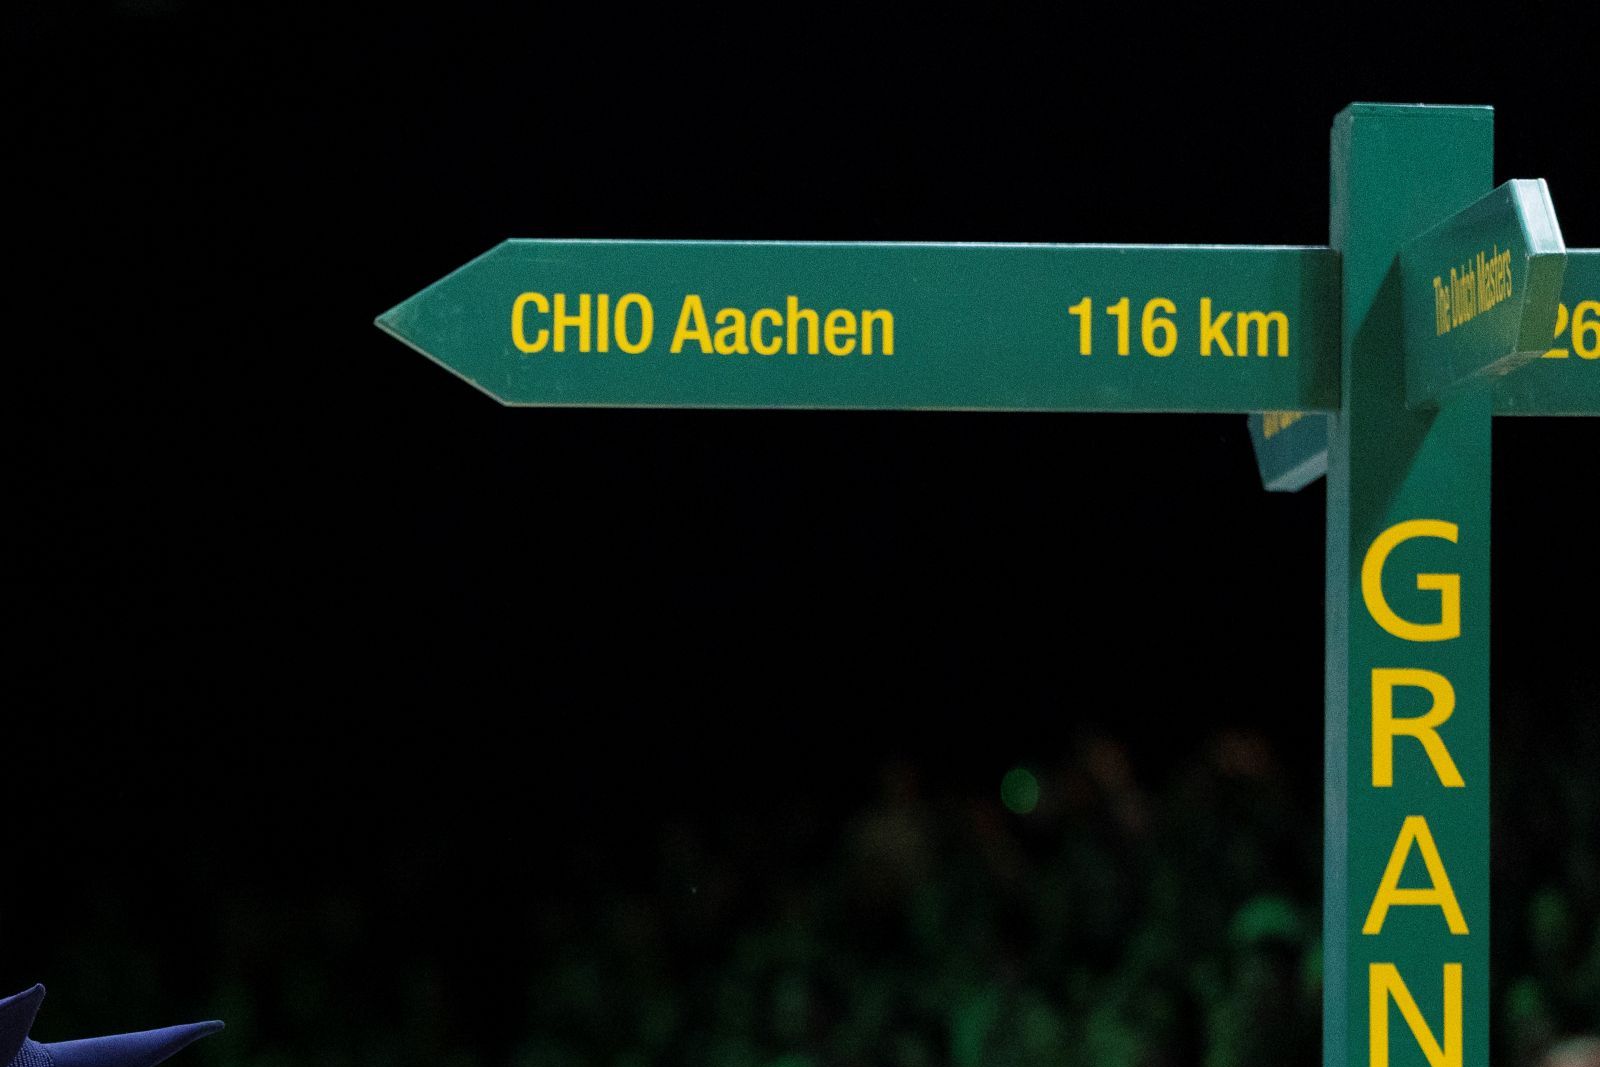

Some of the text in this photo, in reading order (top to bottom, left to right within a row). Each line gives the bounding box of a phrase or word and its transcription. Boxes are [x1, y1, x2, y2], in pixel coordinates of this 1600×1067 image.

[511, 291, 1289, 357] CHIO Aachen 116 km
[1433, 244, 1512, 336] The Dutch Masters
